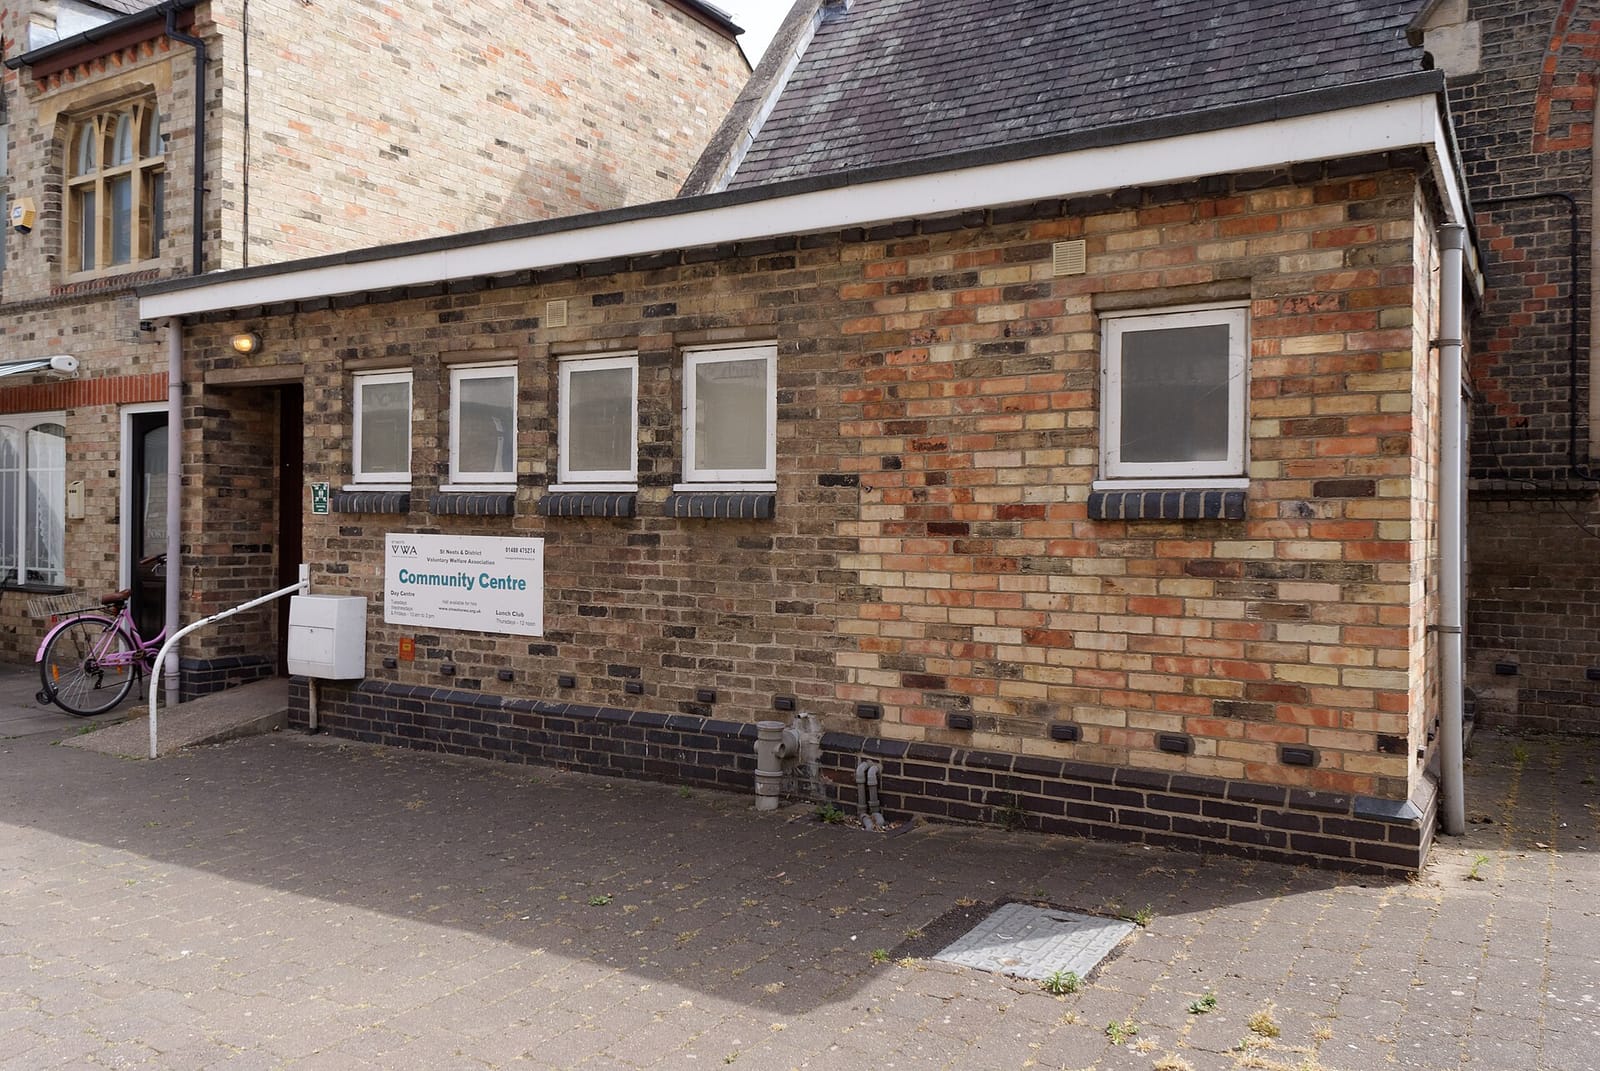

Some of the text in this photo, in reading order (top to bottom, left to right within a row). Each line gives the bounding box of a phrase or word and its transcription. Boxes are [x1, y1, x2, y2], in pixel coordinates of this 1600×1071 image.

[391, 545, 418, 555] VWA
[398, 568, 527, 591] Community Centre
